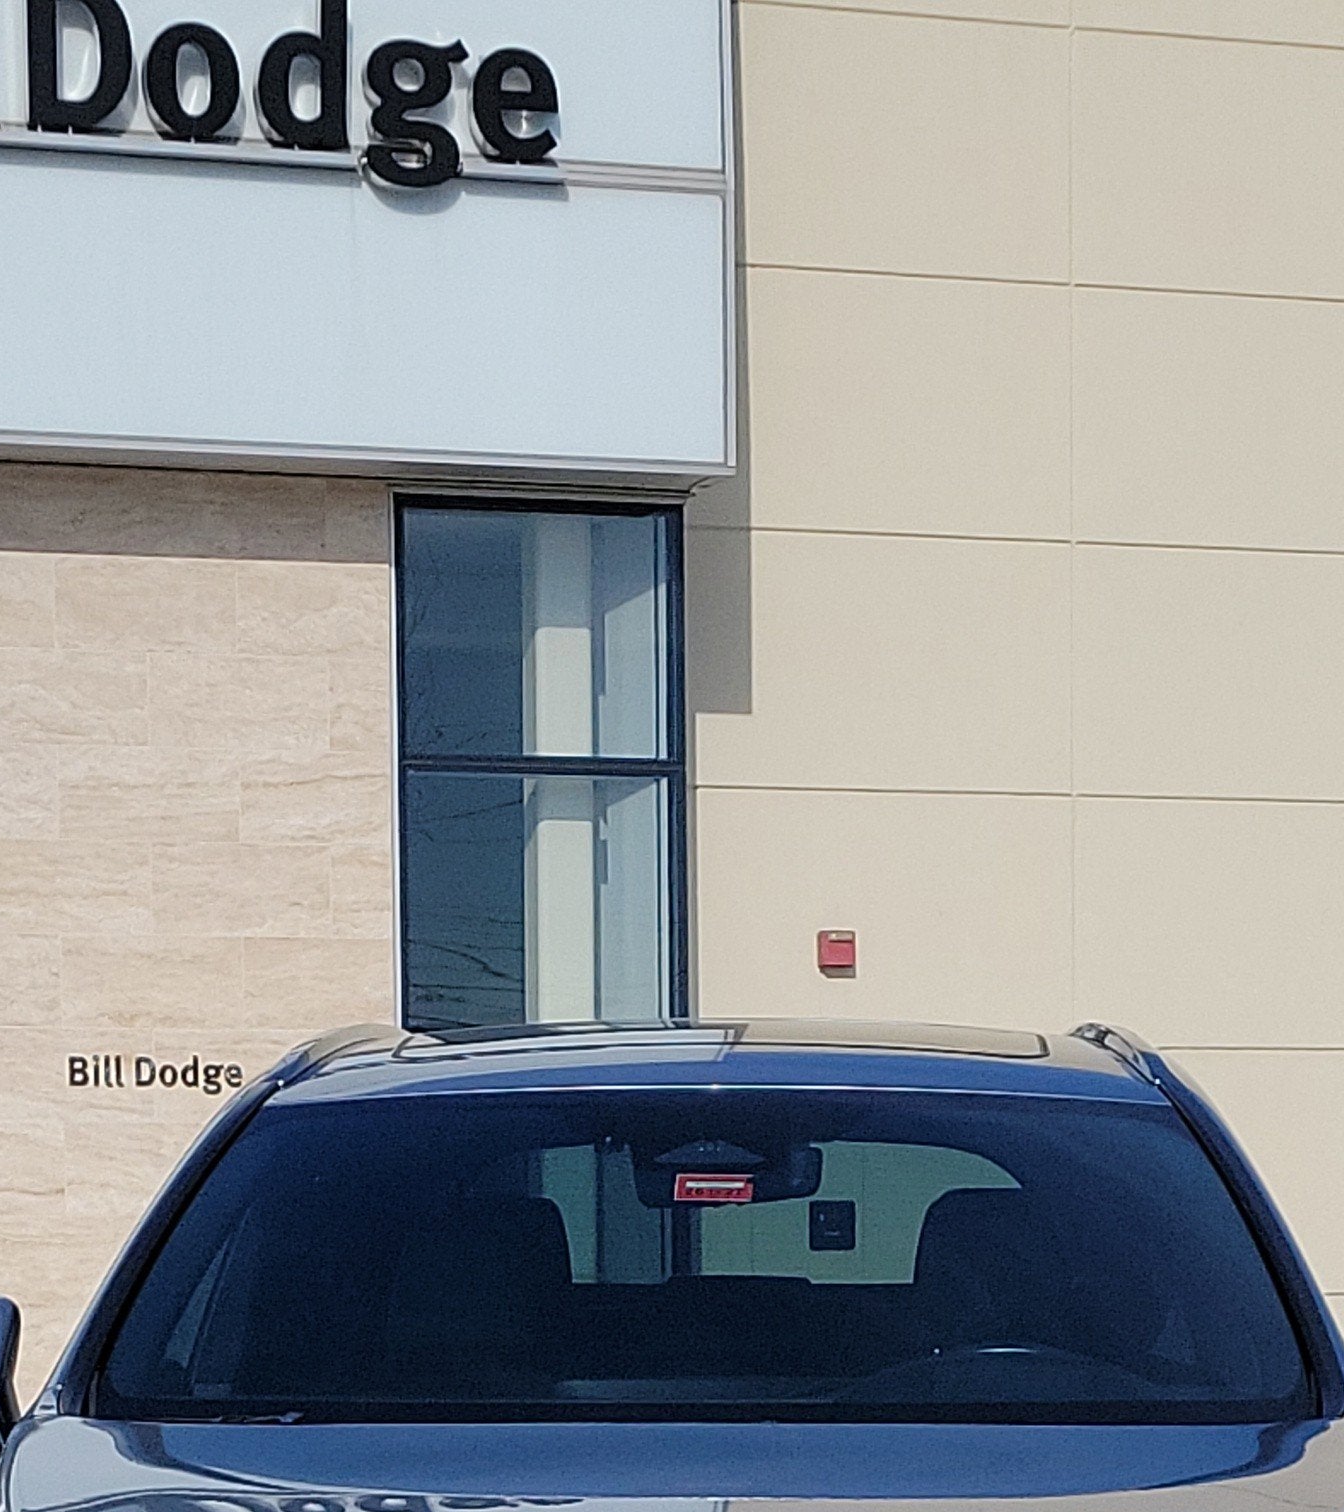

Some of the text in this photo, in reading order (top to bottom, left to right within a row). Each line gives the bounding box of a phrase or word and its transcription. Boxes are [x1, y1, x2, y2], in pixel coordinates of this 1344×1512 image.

[27, 0, 560, 187] Dodge
[68, 1054, 244, 1095] Bill Dodge
